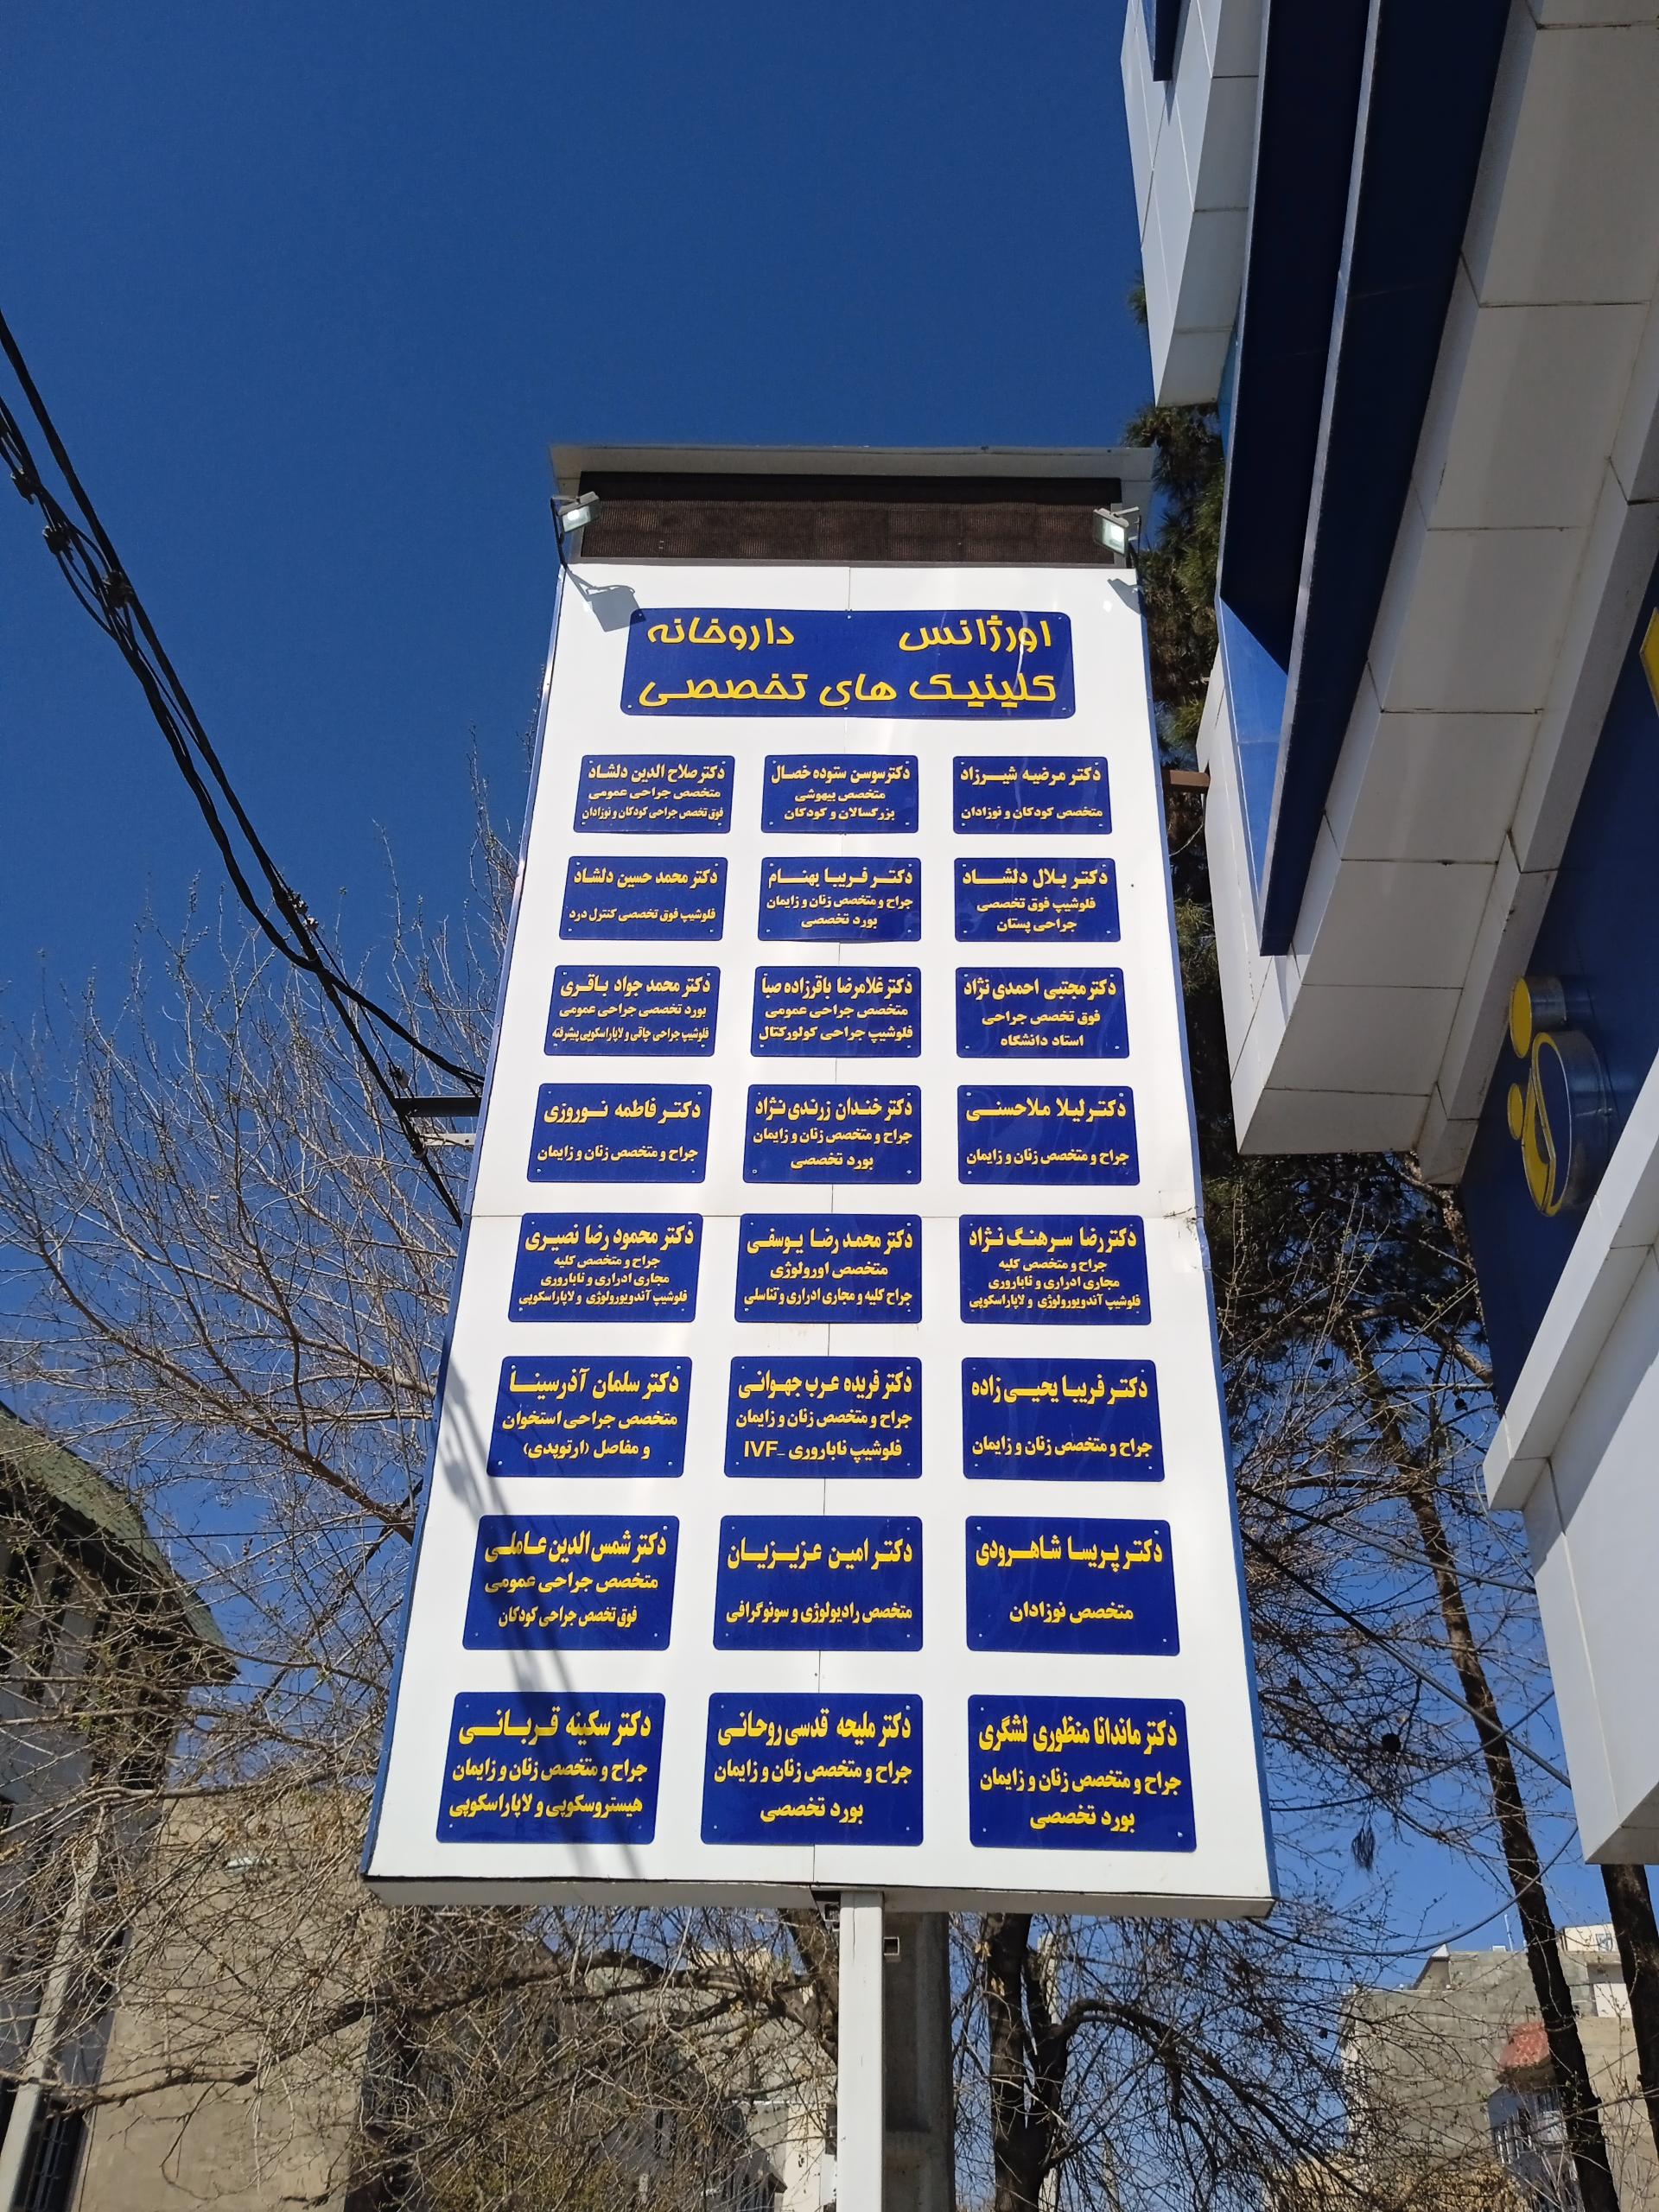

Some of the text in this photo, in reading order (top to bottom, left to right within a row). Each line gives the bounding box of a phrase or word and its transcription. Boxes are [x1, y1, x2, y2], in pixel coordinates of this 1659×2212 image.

[646, 614, 1052, 654] اورژانس داروخانه
[638, 671, 1057, 709] کلینیک های تخصصی
[588, 763, 726, 784] دکتر صلاح الدین دلشاد
[771, 764, 911, 785] دکتر سوسن ستوده خصال
[960, 766, 1102, 786] دکتر مرضیه شیرزاد
[582, 805, 724, 821] فوق تخصص جراحی کودکان و نوزادان
[574, 867, 718, 889] دکتر محمد حسین دلشاد
[768, 868, 913, 889] دکتر فریبا بهنام
[962, 868, 1109, 890] دکتر بلال دلشاد
[569, 907, 716, 924] فلوشیپ فوق تخصصی کنترل درد
[560, 973, 711, 998] دکتر محمد جواد باقری
[761, 976, 782, 999] صبا
[836, 976, 885, 1000] غلامرضا
[883, 977, 913, 1000] دکتر
[963, 977, 1116, 1001] دکتر مجتبی احمدی نژاد
[559, 1003, 707, 1019] بورد تخصصی جراحی عمومی
[759, 1026, 913, 1044] فلوشیپ جراحی کولورکتال
[1001, 1033, 1084, 1046] استاد دانشگاه
[543, 1097, 702, 1124] دکتر فاطمه نوروزی
[754, 1096, 912, 1122] دکتر خندان زرندی نژاد
[1055, 1097, 1085, 1122] لیلا
[1085, 1099, 1127, 1122] دکتر
[753, 1128, 912, 1145] جراح و متخصص زنان و زایمان
[524, 1224, 695, 1252] دکتر محمود رضا نصیری
[747, 1227, 913, 1255] دکتر محمد رضا یوسفی
[969, 1226, 1137, 1254] دکتر رضا سرهنگ نژاد
[770, 1261, 889, 1280] متخصص اورولوژی
[988, 1274, 1121, 1291] مجاری ادراری و ناباروری
[592, 1370, 640, 1400] سلمان
[641, 1370, 680, 1400] دکتر
[804, 1375, 840, 1399] عرب
[842, 1369, 880, 1400] فریده
[881, 1370, 912, 1400] دکتر
[971, 1373, 1148, 1405] دکتر فریبا یحیی زاده
[501, 1409, 678, 1430] متخصص جراحی استخوان
[735, 1408, 913, 1429] جراح و متخصص زنان و زایمان
[593, 1439, 639, 1459] مفاصل
[640, 1446, 651, 1459] و
[788, 1440, 848, 1461] ناباروری
[849, 1439, 903, 1464] فلوشیپ
[484, 1529, 668, 1564] دکتر شمس الدین عاملی
[727, 1537, 913, 1570] دکتر امین عزیزیان
[975, 1535, 1163, 1573] دکتر پریسا شاهرودی
[726, 1600, 913, 1624] متخصص رادیولوژی و سونوگرافی
[1009, 1600, 1135, 1624] متخصص نوزادان
[458, 1706, 652, 1746] دکتر سکینه قربانی
[717, 1708, 912, 1748] دکتر ملیحه قدسی روحانی
[1033, 1715, 1090, 1752] منظوری
[1093, 1716, 1141, 1745] ماندانا
[1143, 1719, 1179, 1755] دکتر
[534, 1801, 543, 1818] و
[1030, 1804, 1135, 1834] بورد تخصصی
